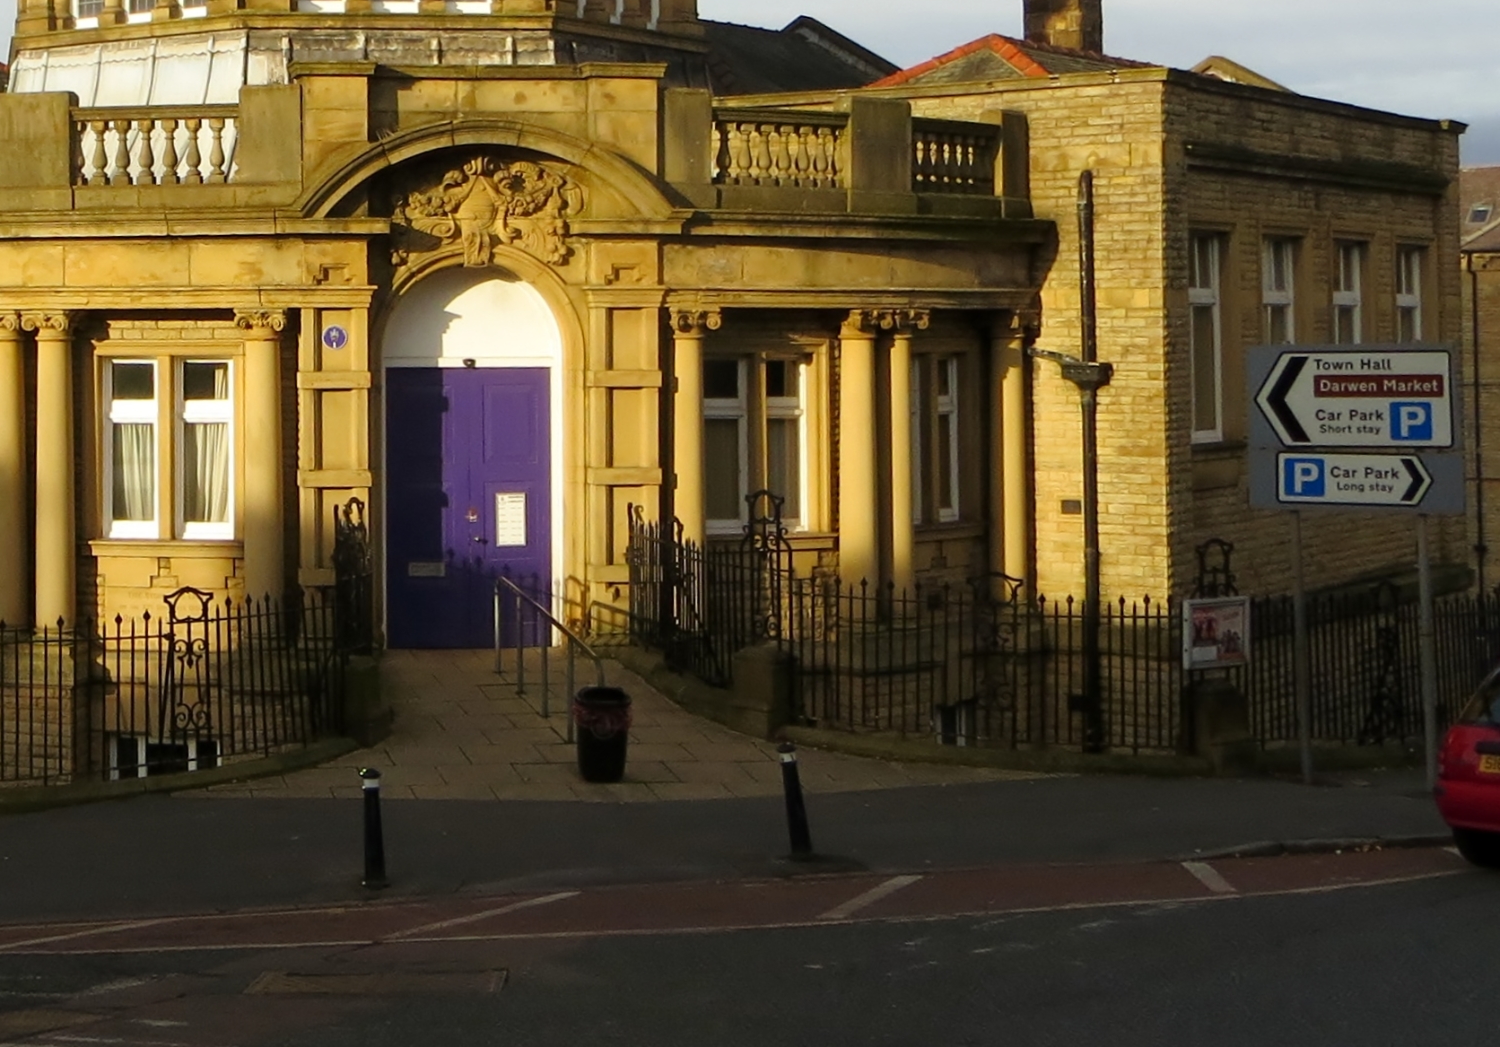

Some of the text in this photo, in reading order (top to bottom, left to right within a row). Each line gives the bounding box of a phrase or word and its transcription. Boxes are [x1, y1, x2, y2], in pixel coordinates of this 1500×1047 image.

[1314, 358, 1391, 371] Town Hall
[1319, 379, 1439, 392] Darwen Market
[1315, 409, 1384, 421] Car Park
[1399, 406, 1426, 437] P
[1319, 423, 1381, 436] Short stay
[1293, 461, 1319, 494] P
[1330, 466, 1400, 479] Car Park
[1336, 481, 1395, 493] Long stay
